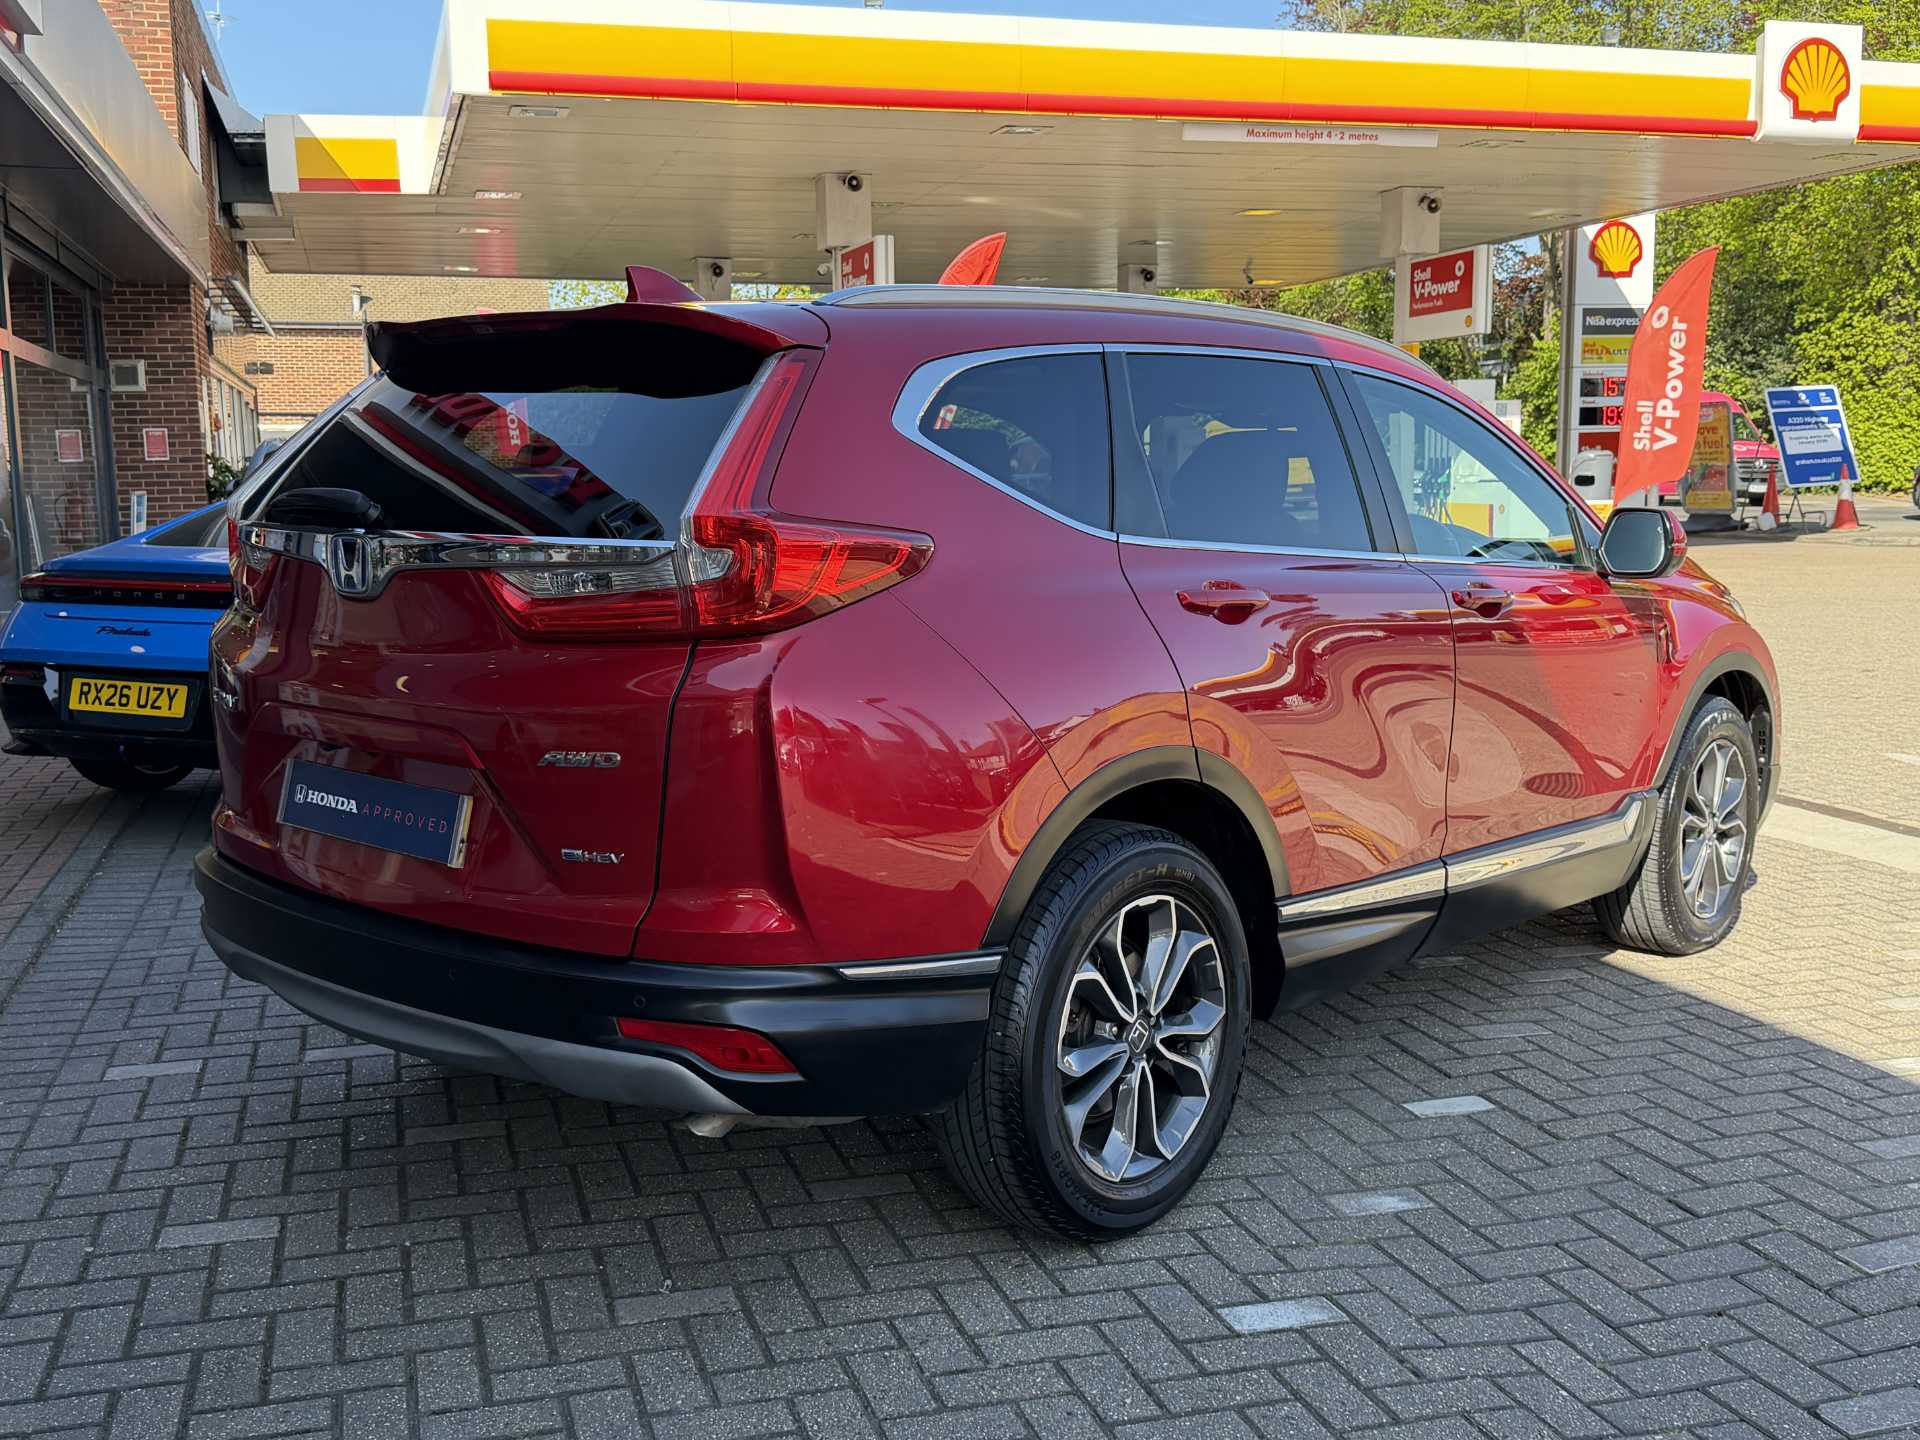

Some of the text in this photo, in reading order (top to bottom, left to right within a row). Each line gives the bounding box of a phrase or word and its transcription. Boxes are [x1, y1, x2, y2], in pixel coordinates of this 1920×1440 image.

[1246, 128, 1292, 138] Maximum
[1295, 128, 1323, 141] height
[1348, 132, 1379, 141] metres
[1414, 266, 1432, 281] Shell
[1414, 279, 1461, 299] V-Power
[1652, 316, 1688, 451] V-Power
[1633, 400, 1655, 451] Shell
[78, 682, 178, 711] RX26 UZY
[537, 751, 622, 768] AWD
[307, 790, 448, 833] HONDA APPROVED
